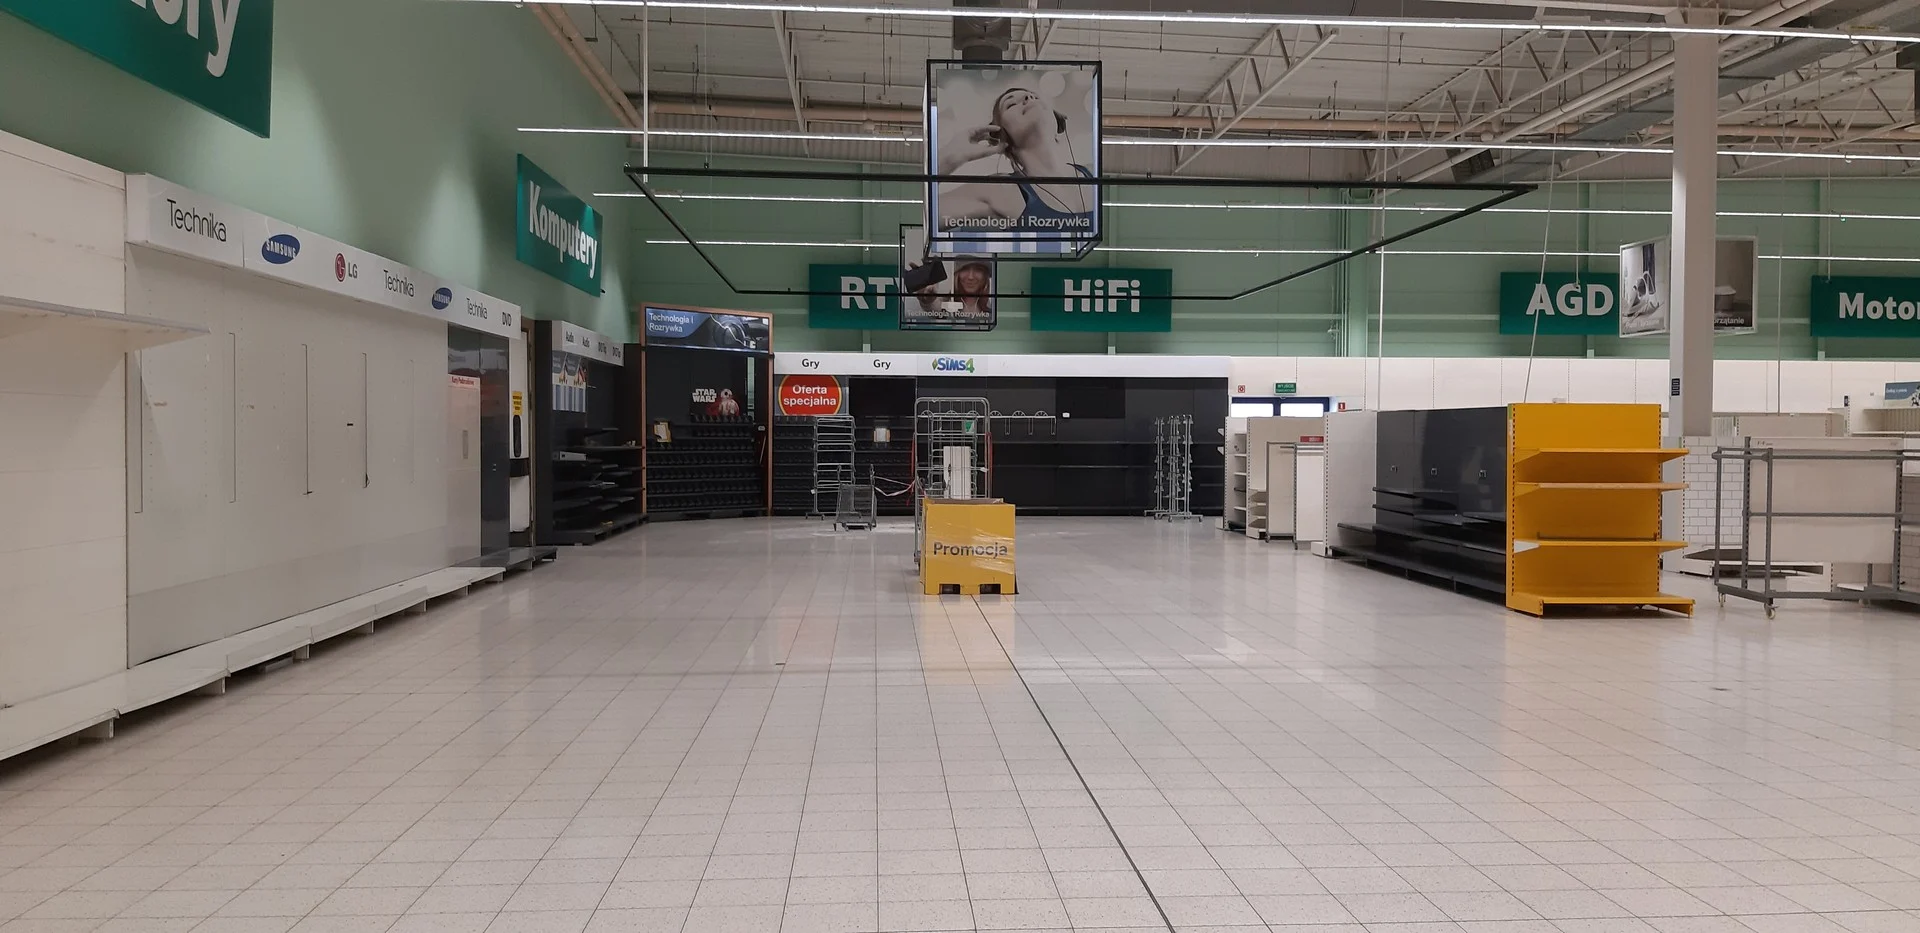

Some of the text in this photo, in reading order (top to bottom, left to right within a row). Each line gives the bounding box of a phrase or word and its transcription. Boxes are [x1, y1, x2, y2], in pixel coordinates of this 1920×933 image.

[166, 198, 227, 243] Technika
[944, 215, 1090, 230] Technologia i Rozrywka
[529, 180, 598, 279] Komputery
[265, 240, 297, 259] SAMSUNG
[347, 262, 358, 279] LG
[383, 269, 415, 297] Technika
[1064, 279, 1140, 313] HiFi
[1525, 283, 1614, 317] AGD
[466, 297, 488, 319] Technika
[1839, 292, 1920, 320] Moto
[502, 311, 512, 327] DVD
[649, 313, 689, 325] Technologia
[907, 310, 949, 318] Technologia
[955, 311, 990, 319] Rozrywka
[649, 323, 683, 333] Rozrywka
[801, 358, 820, 369] Gry
[873, 359, 891, 370] Gry
[694, 389, 716, 397] STAR
[792, 384, 828, 395] Oferta
[692, 395, 717, 403] WARS
[783, 396, 836, 408] specjalna
[933, 541, 1008, 559] Promocja
